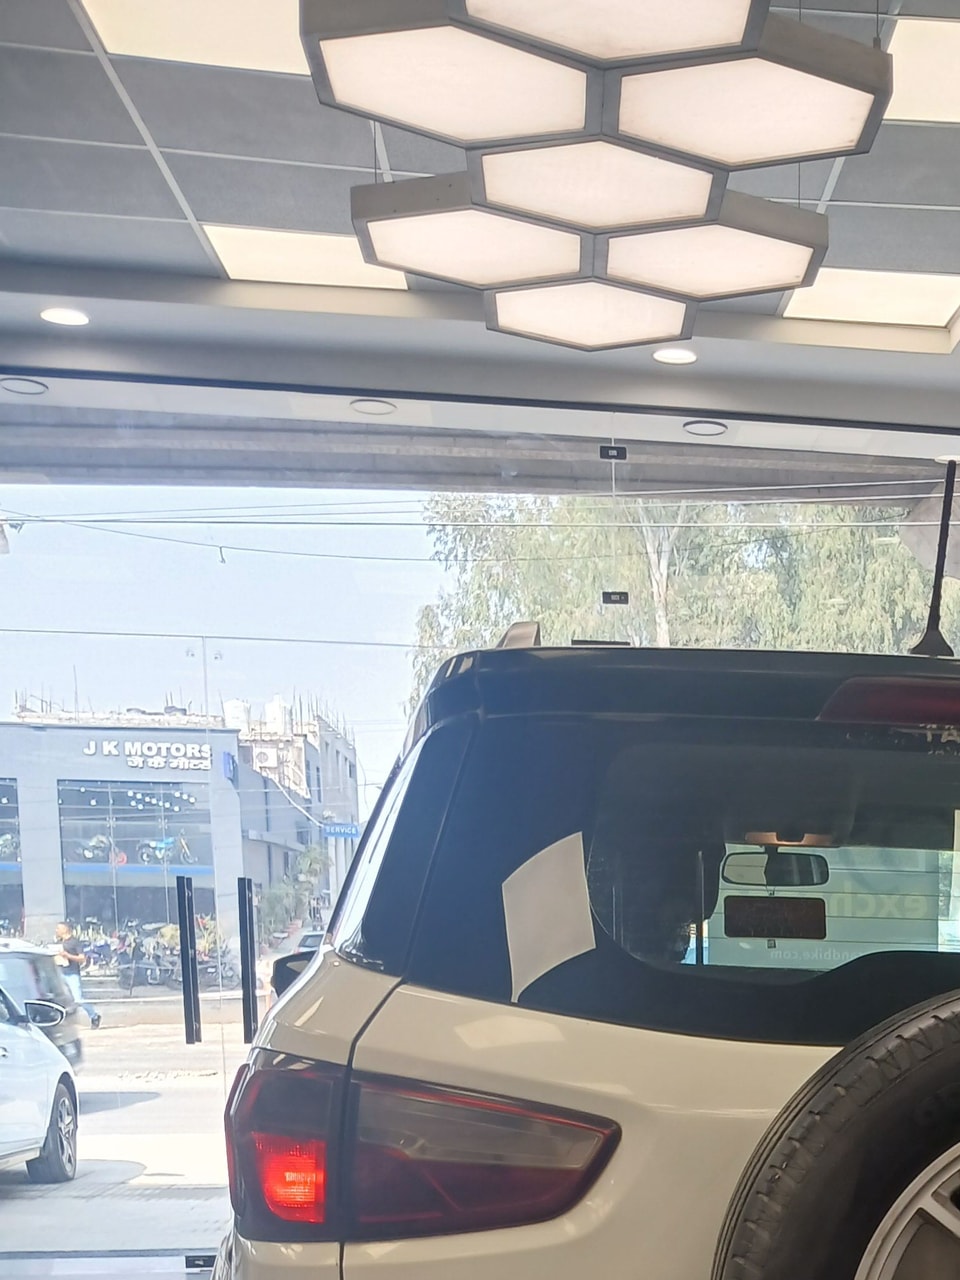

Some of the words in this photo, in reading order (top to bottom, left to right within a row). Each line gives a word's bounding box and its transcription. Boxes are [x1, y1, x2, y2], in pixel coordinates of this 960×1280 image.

[83, 740, 96, 755] J
[102, 740, 119, 756] K
[124, 741, 212, 758] MOTORS
[324, 825, 357, 835] SERVICE
